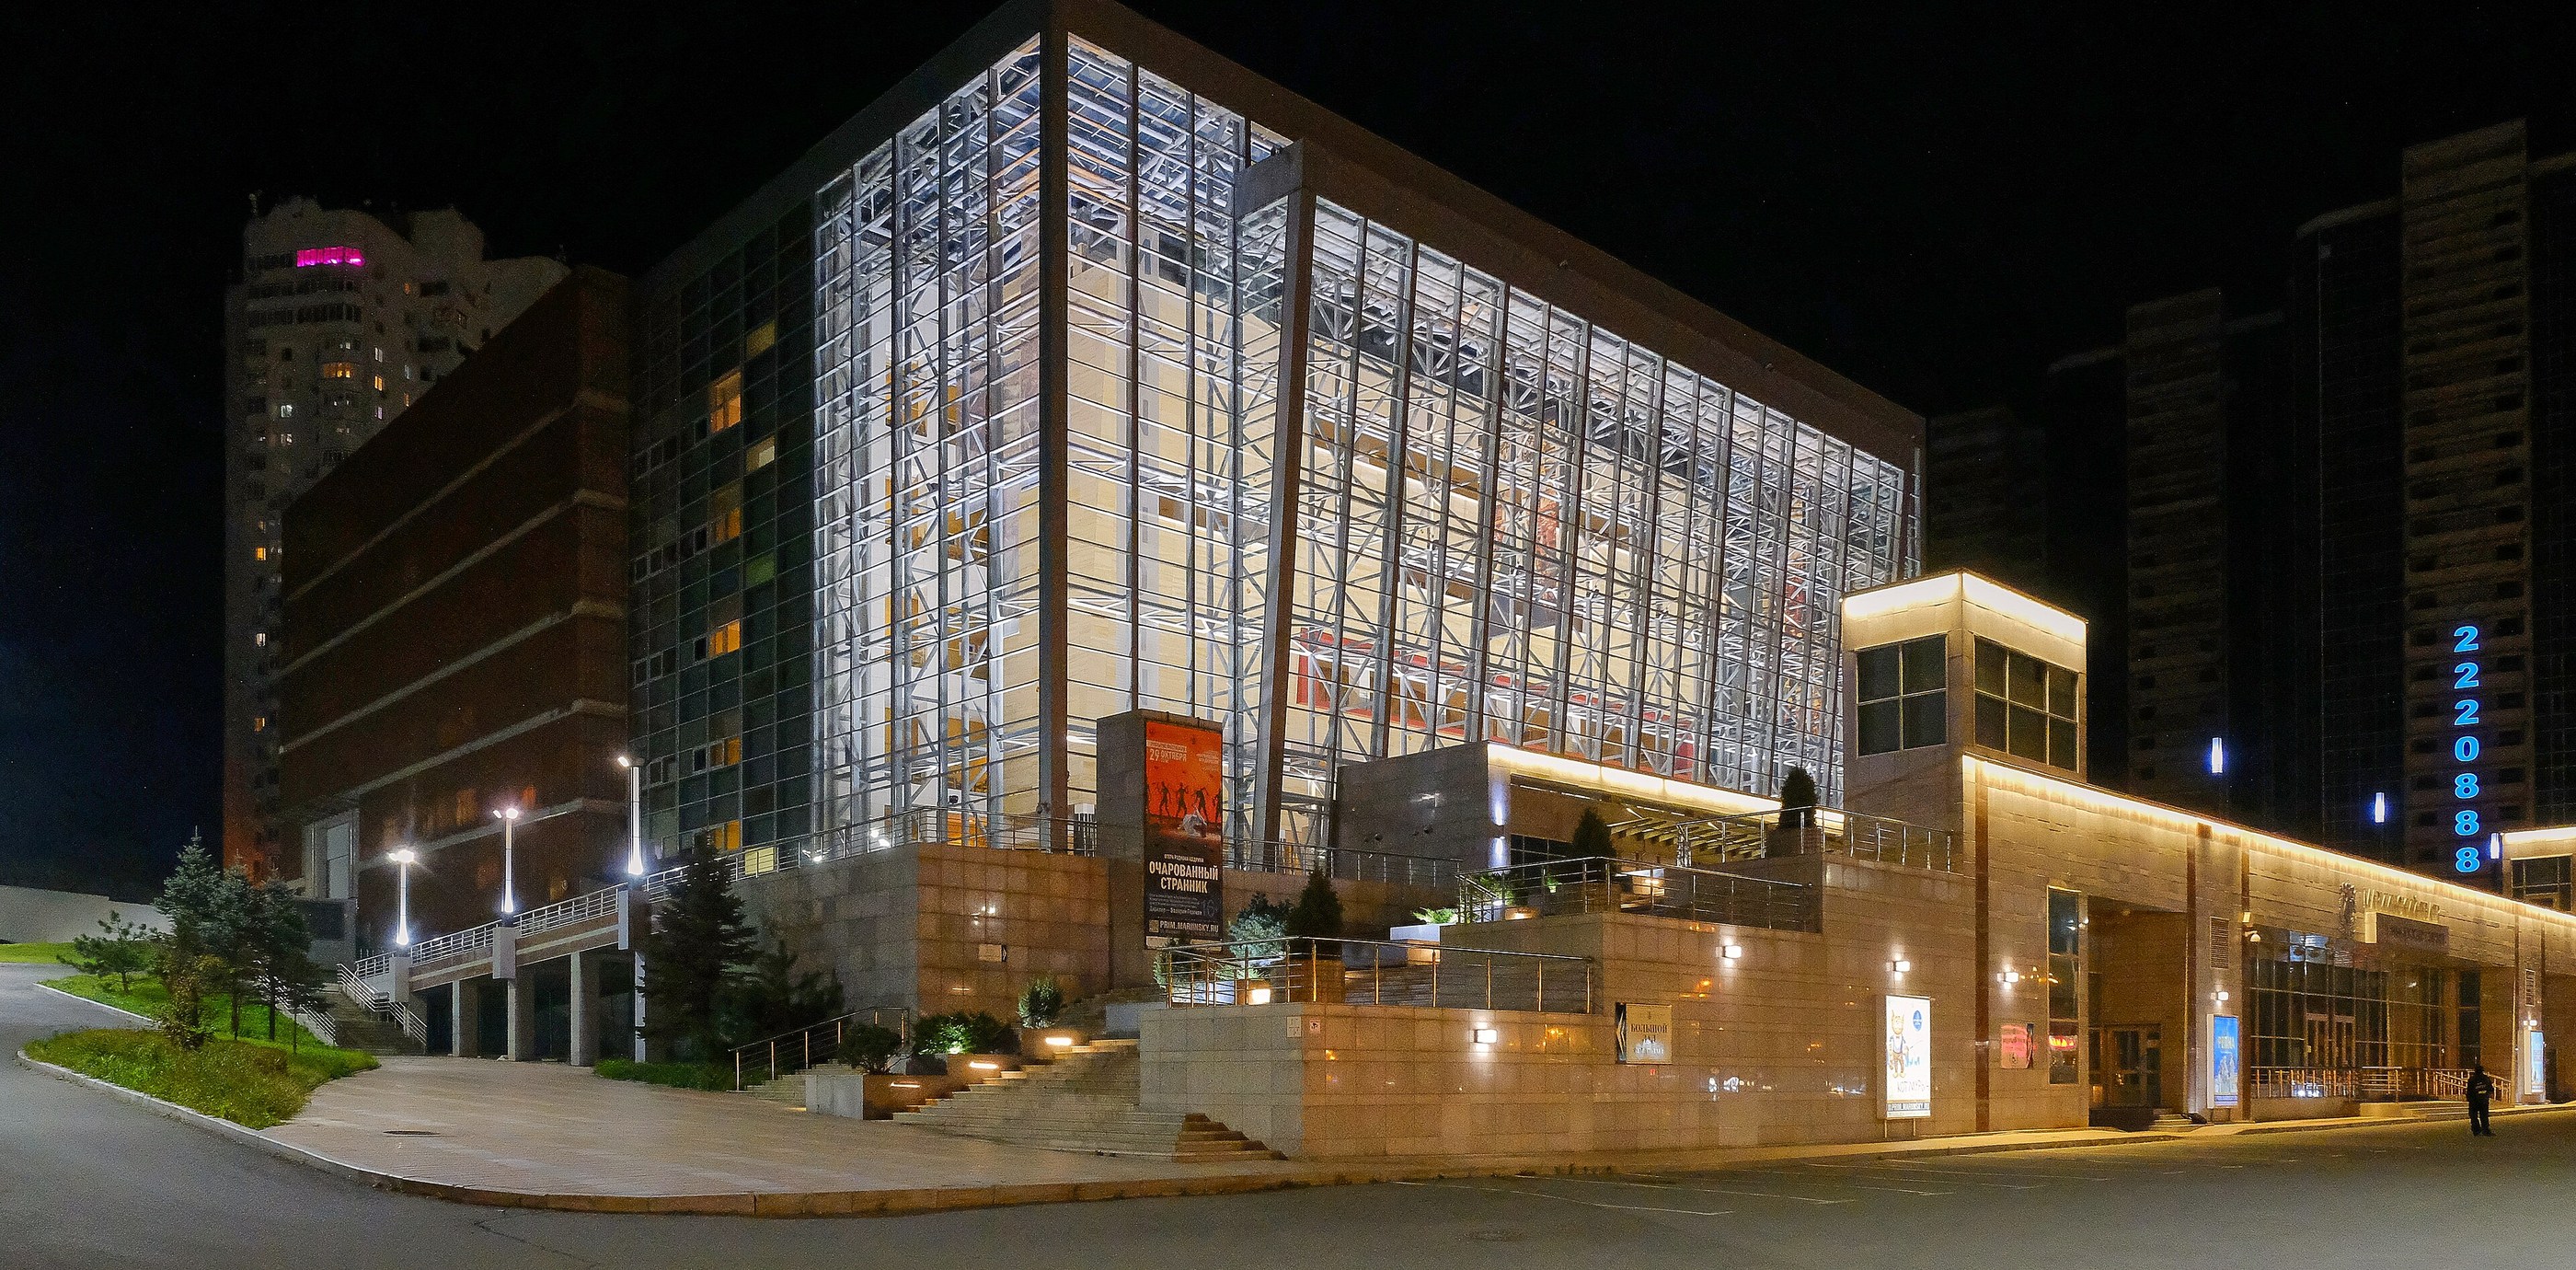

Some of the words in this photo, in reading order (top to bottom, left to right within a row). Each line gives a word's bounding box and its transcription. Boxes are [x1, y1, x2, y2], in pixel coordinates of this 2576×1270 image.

[1149, 748, 1160, 761] 29
[1160, 751, 1187, 762] ОКТЯБРЯ
[2454, 626, 2480, 872] 2220888
[1149, 860, 1219, 880] ОЧАРОВАННЫЙ
[1160, 876, 1208, 894] СТРАННИК
[1630, 1022, 1667, 1033] БОЛЬШОЙ
